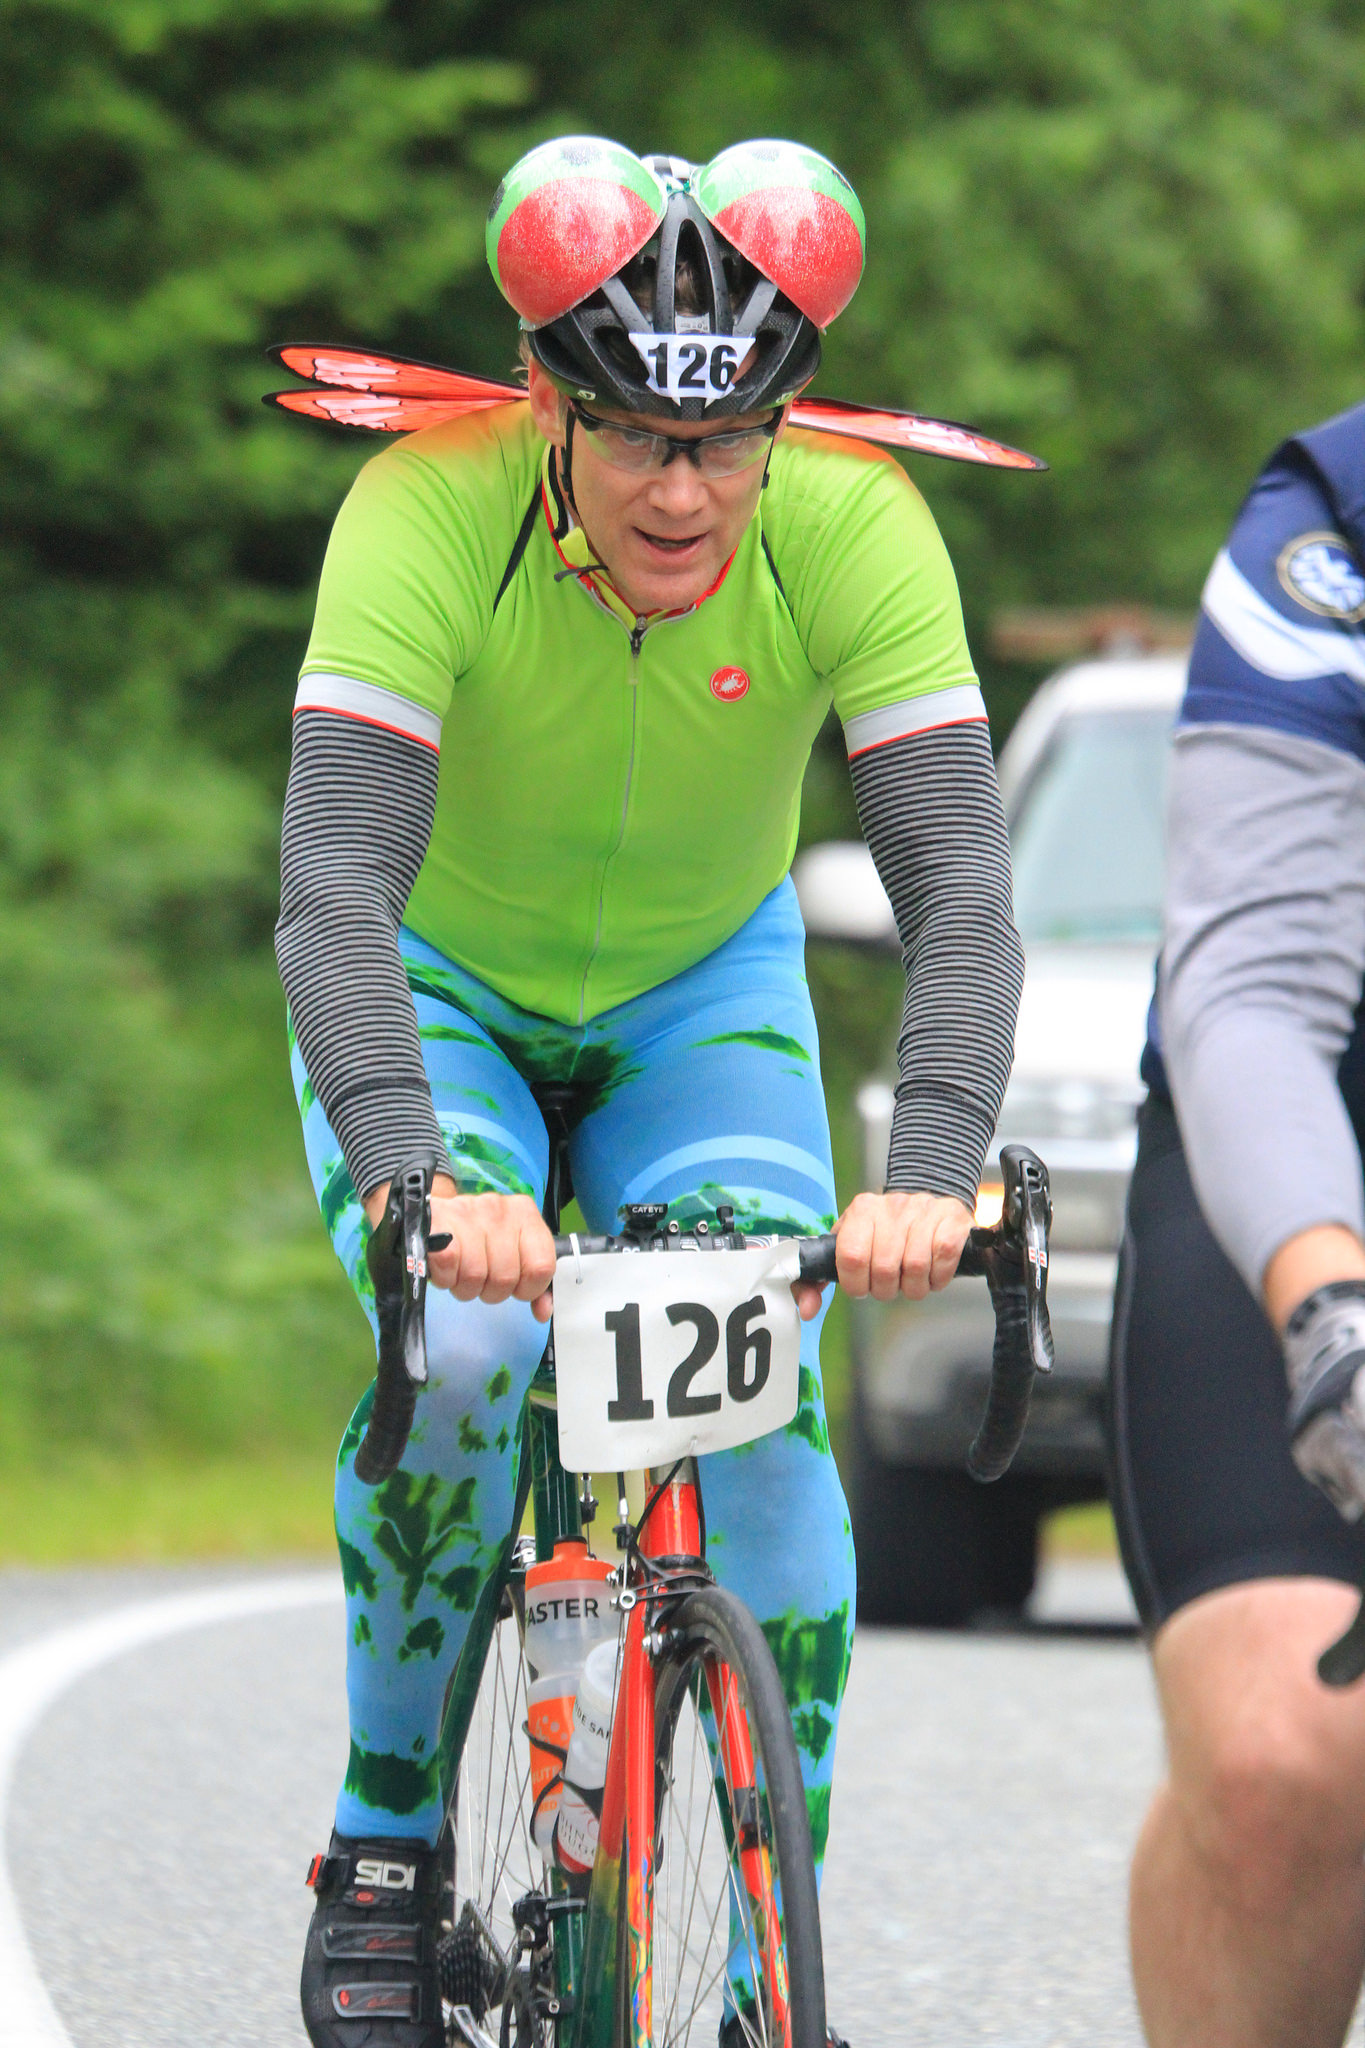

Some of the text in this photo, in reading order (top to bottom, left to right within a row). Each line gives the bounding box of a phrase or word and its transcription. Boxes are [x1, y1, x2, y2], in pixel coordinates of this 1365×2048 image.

[647, 342, 738, 392] 126
[631, 1206, 664, 1214] CATEYE
[605, 1295, 772, 1423] 126
